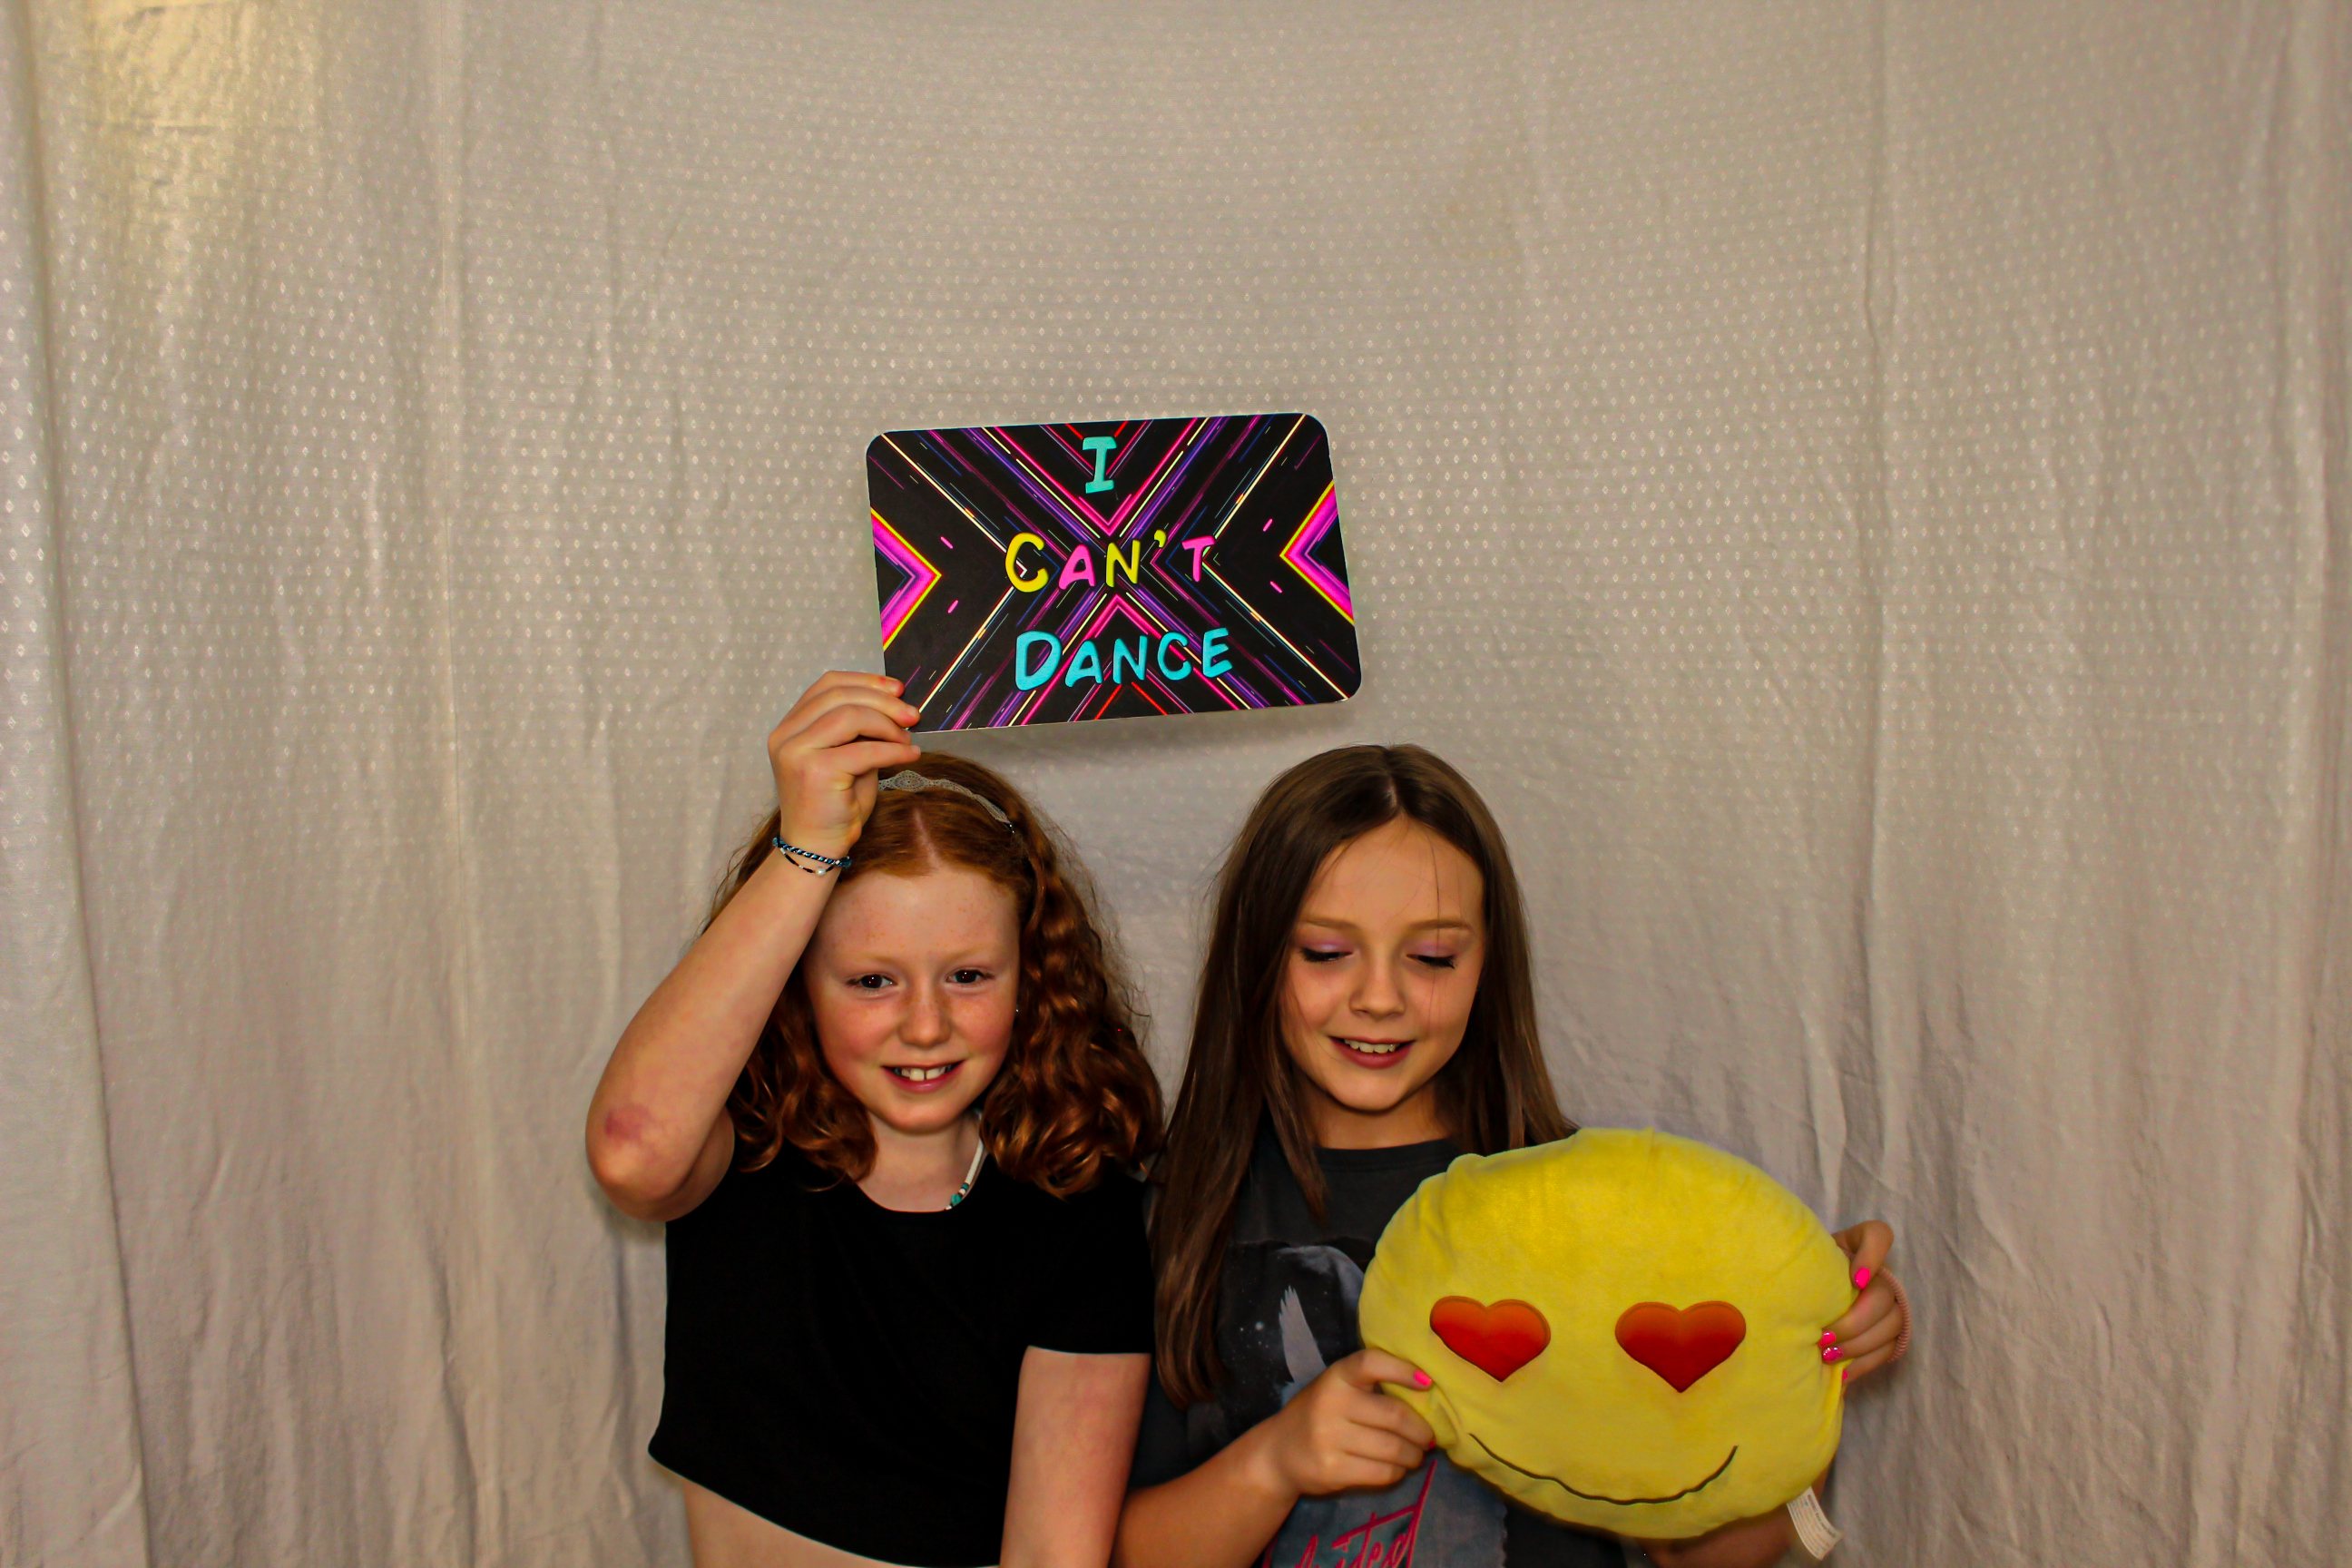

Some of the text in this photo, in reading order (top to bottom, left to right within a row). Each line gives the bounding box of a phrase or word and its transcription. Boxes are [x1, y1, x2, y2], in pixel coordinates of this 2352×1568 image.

[1082, 436, 1117, 494] I
[1004, 529, 1217, 593] CAN'T
[1014, 627, 1233, 691] DANCE
